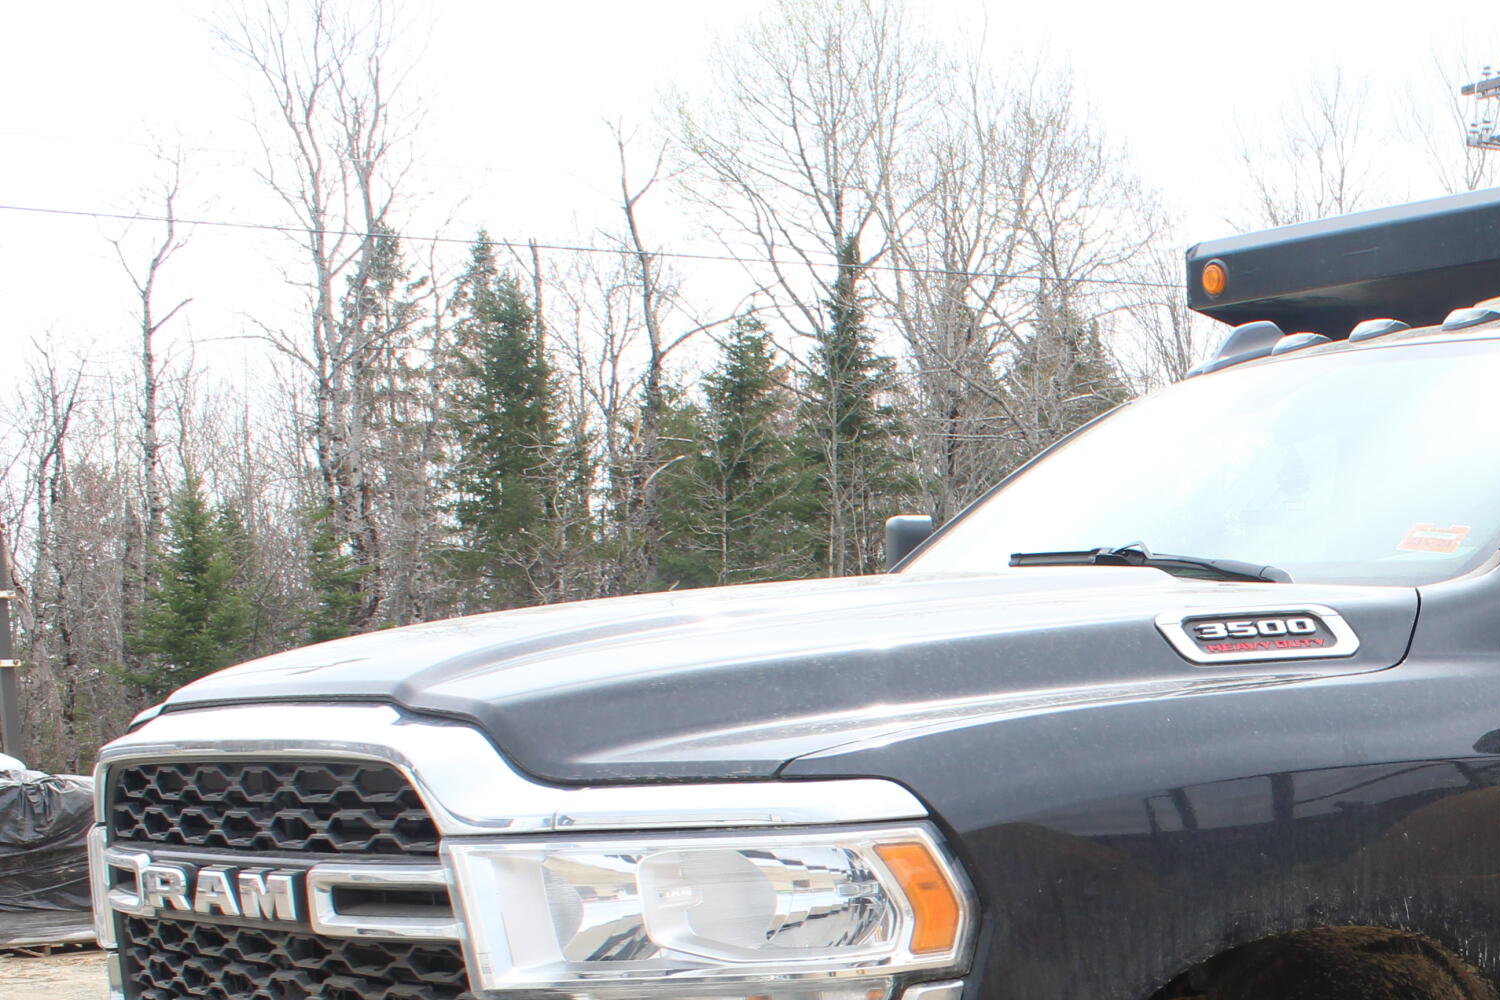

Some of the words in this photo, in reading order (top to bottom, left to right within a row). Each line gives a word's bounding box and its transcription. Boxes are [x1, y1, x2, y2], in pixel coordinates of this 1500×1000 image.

[1196, 617, 1317, 641] 3500
[1206, 640, 1271, 653] HEAVY
[1275, 638, 1326, 650] DUTY
[145, 864, 298, 921] RAM
